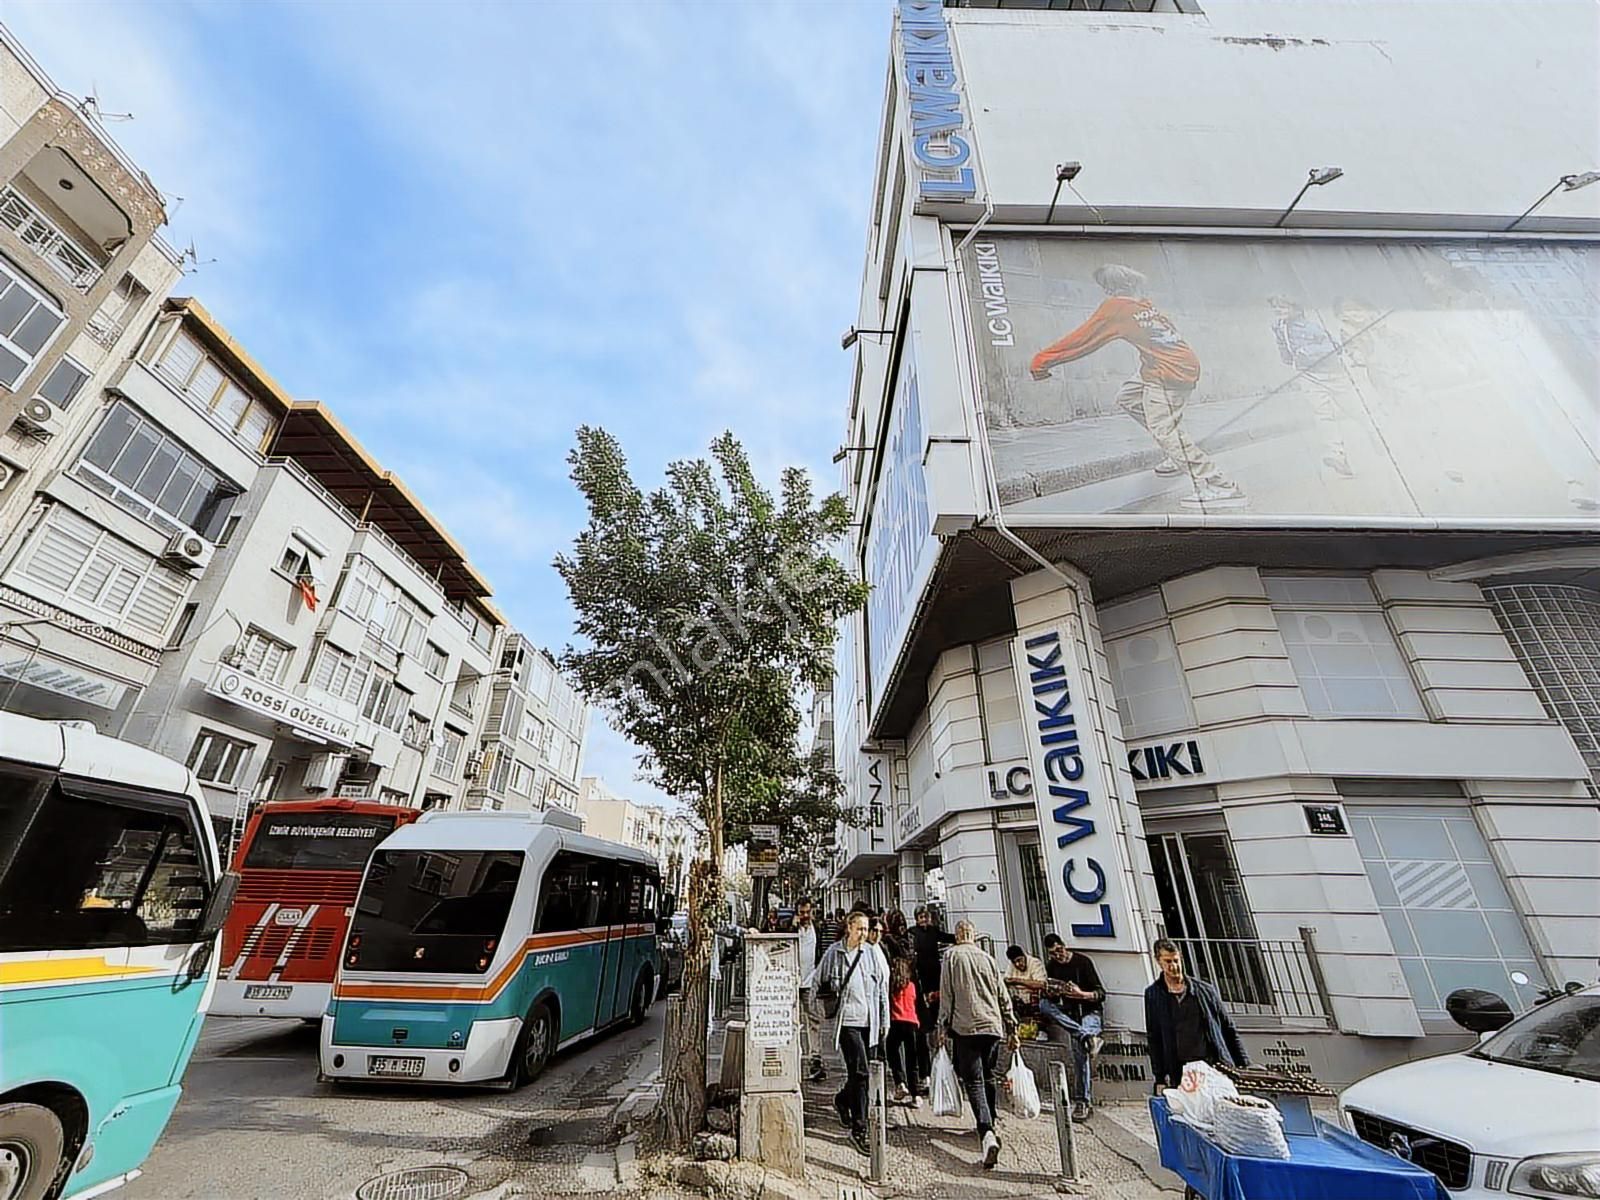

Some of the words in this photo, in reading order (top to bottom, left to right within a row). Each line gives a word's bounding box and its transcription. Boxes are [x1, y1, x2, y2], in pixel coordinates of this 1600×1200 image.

[913, 136, 976, 198] LC
[988, 319, 1014, 346] LC
[290, 706, 350, 738] GÜZELLİK
[988, 766, 1032, 800] LC
[1062, 857, 1116, 938] LC
